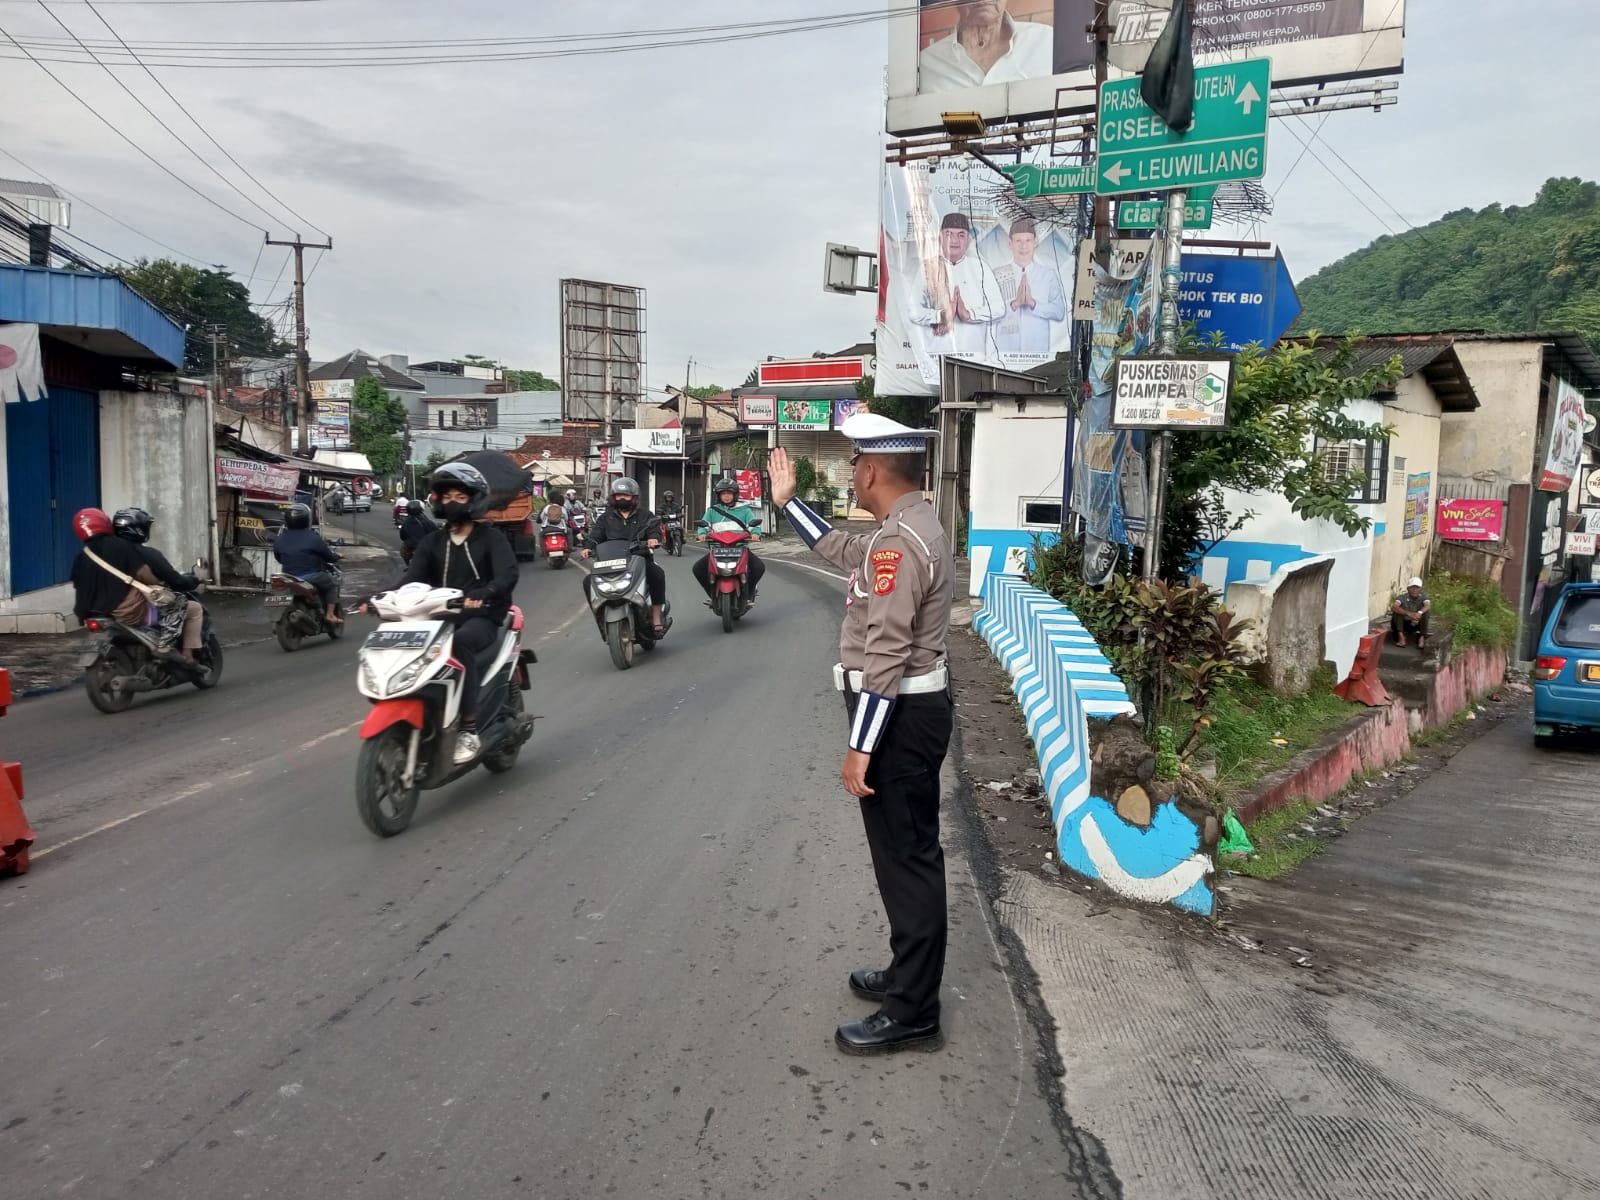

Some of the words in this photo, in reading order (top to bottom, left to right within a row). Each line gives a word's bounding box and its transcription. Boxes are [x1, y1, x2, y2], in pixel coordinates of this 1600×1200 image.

[1243, 2, 1326, 22] (0800-177-6565)
[1217, 31, 1260, 43] MEMBERI
[1262, 26, 1300, 39] KEPADA
[1138, 147, 1259, 181] LEUWILIANG
[1211, 291, 1237, 303] TEK
[1240, 293, 1264, 305] BIO
[1197, 309, 1212, 319] KM
[1120, 363, 1197, 380] PUSKESMAS
[1118, 383, 1188, 399] CIAMPEA
[1139, 408, 1161, 419] METER
[1442, 510, 1464, 519] VIVI
